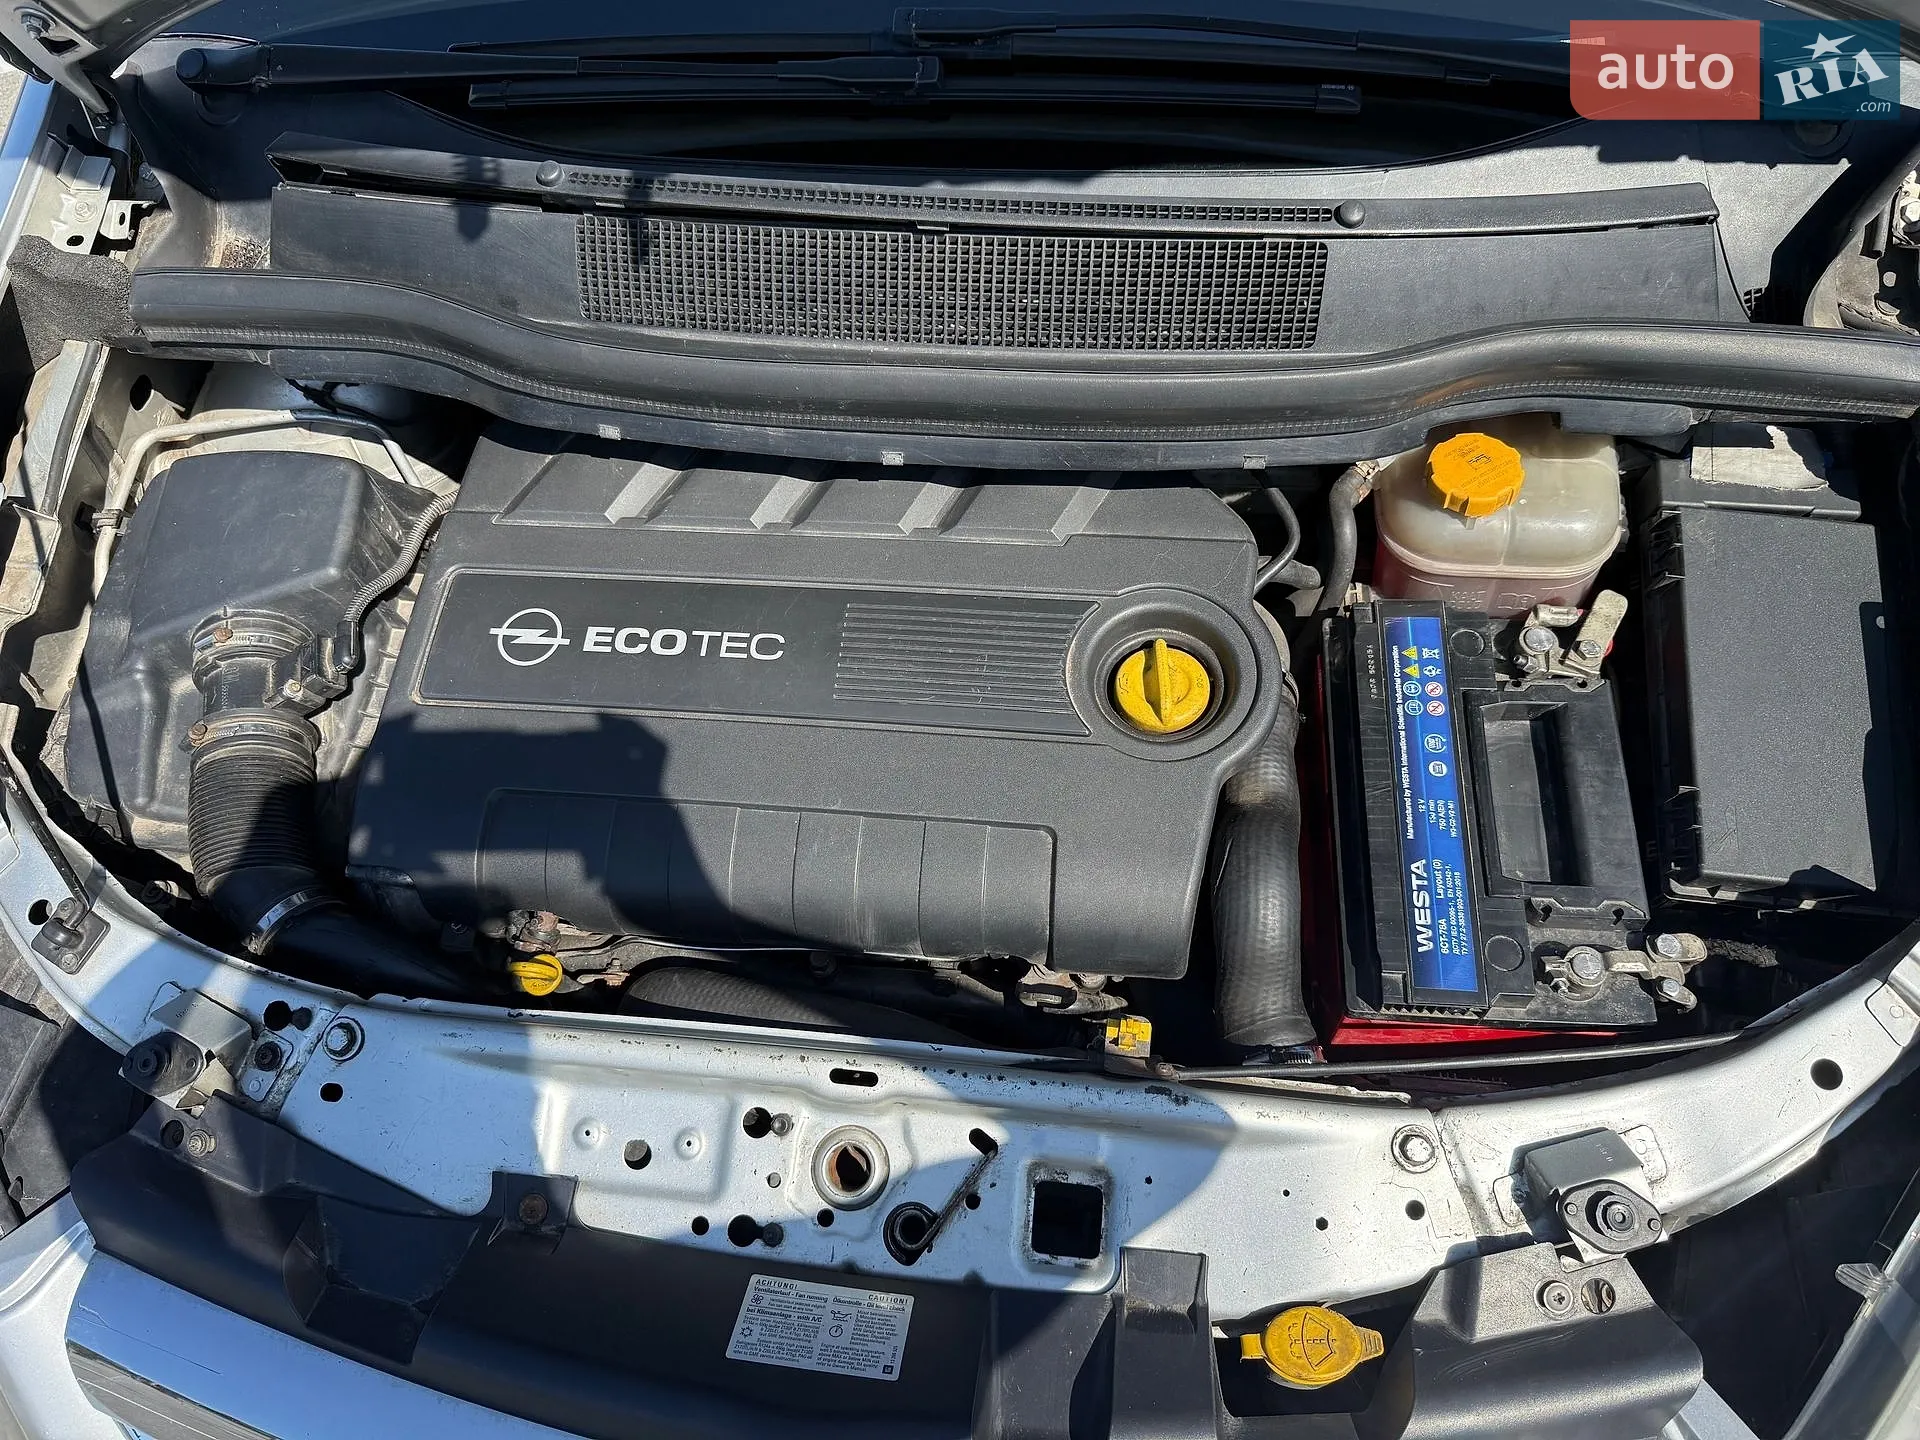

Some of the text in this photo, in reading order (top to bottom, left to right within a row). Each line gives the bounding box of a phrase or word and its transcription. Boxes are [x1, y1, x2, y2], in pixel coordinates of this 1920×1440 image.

[583, 626, 786, 660] ECOTEC
[1392, 646, 1414, 839] Manufactured by WESTA International Scientific Industrial Corporation
[1434, 871, 1444, 898] Layout
[1447, 889, 1454, 897] EN
[1410, 858, 1434, 953] WESTA
[756, 1279, 797, 1289] ACHTUNG!
[868, 1294, 908, 1305] CAUTION!
